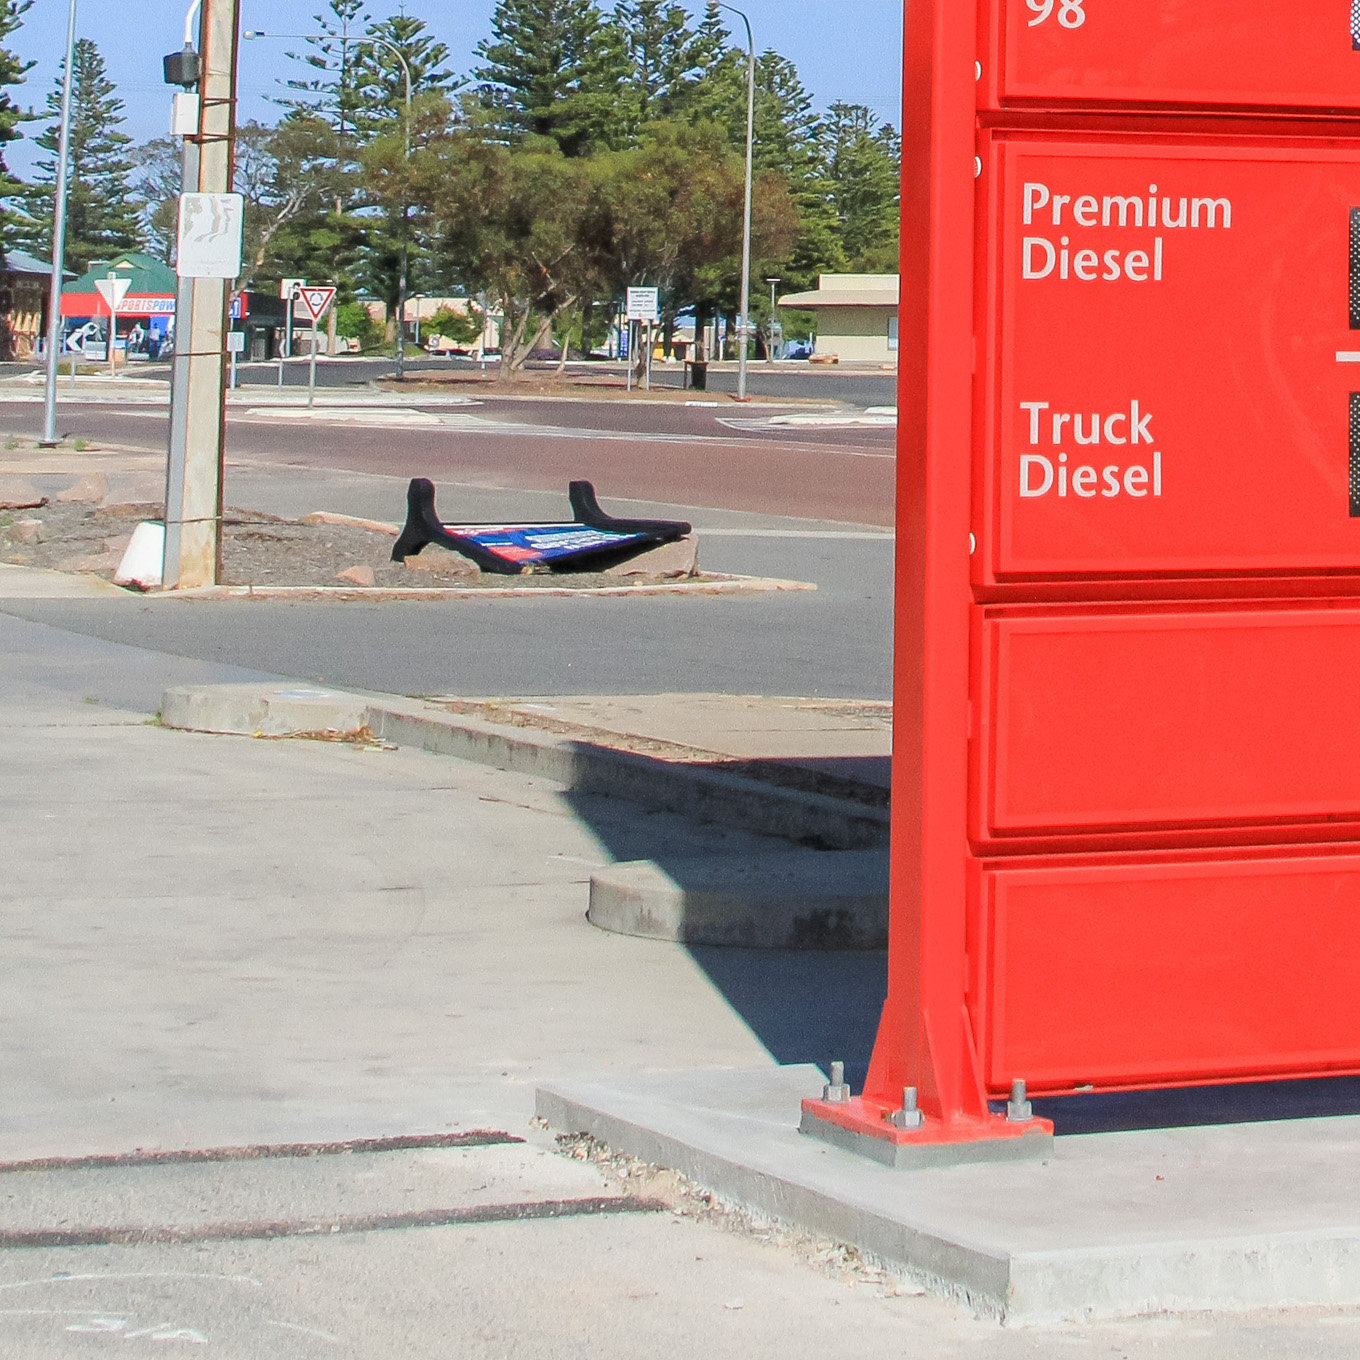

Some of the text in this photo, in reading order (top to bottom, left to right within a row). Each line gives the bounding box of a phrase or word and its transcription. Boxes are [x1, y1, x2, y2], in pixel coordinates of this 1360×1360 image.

[1022, 182, 1232, 229] Premium
[1022, 235, 1163, 282] Diesel
[1019, 399, 1155, 445] Truck
[1019, 451, 1163, 498] Diesel
